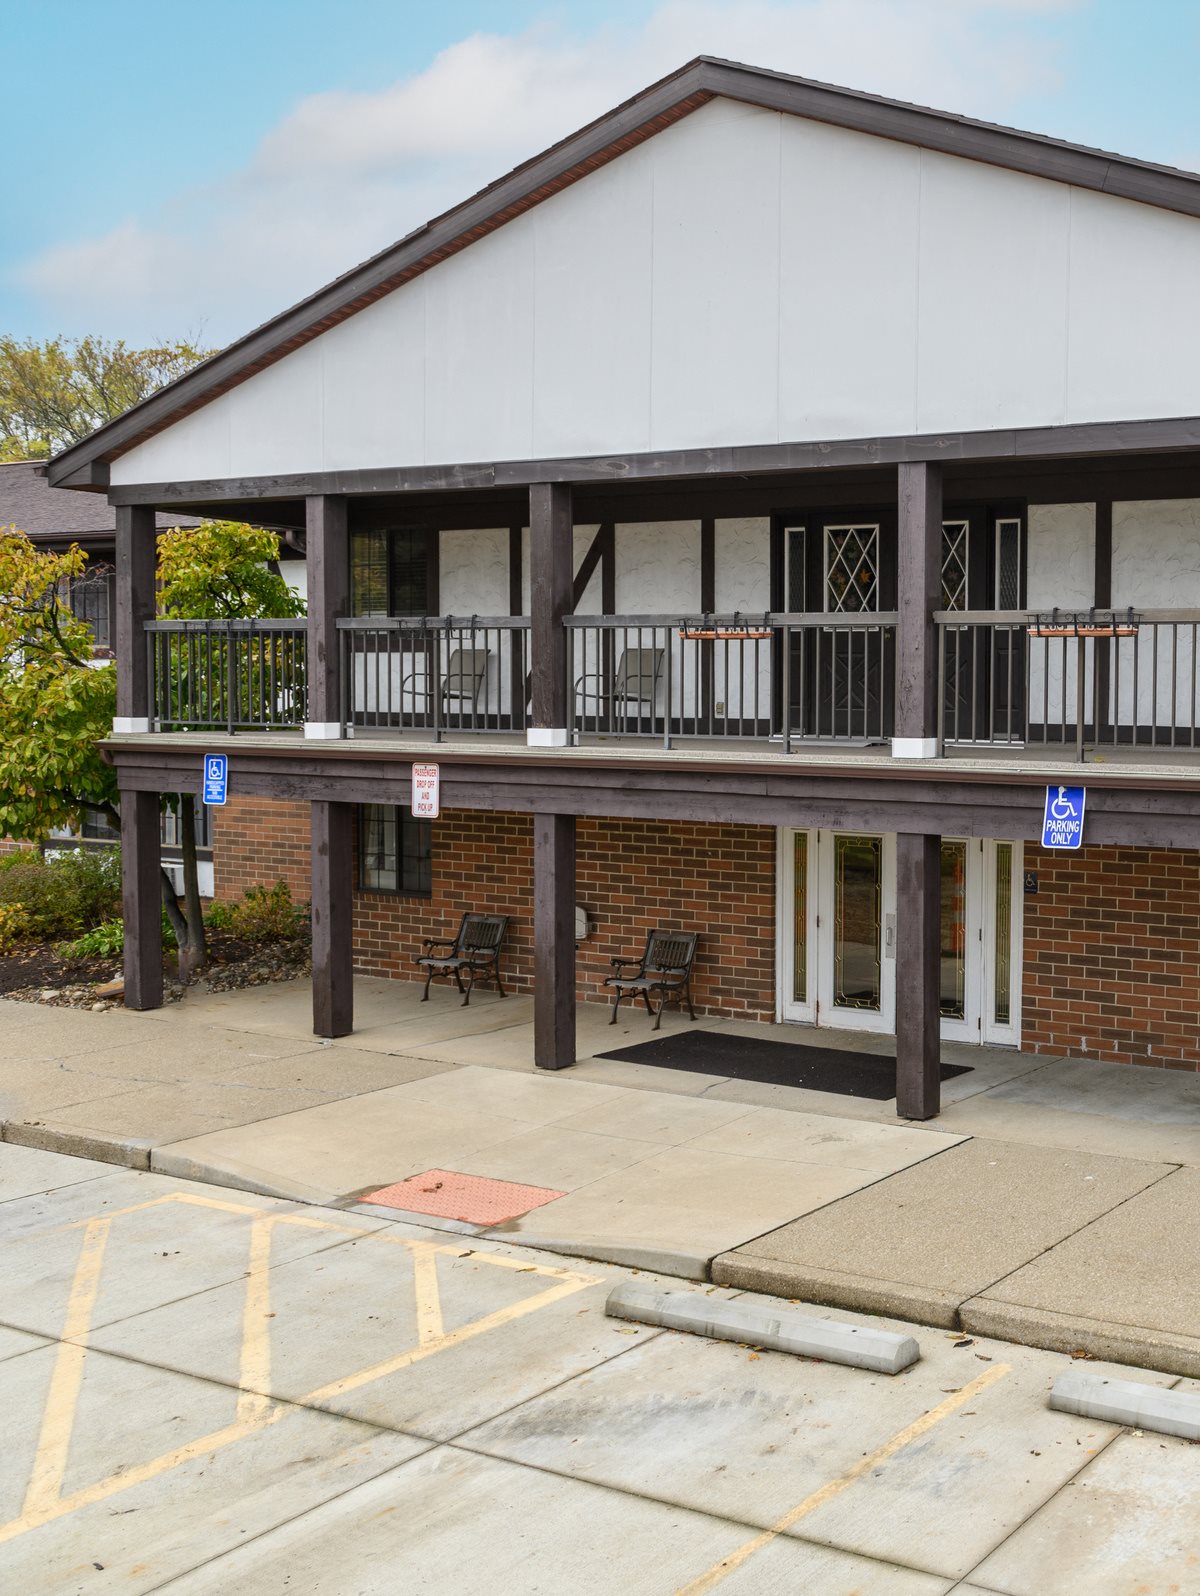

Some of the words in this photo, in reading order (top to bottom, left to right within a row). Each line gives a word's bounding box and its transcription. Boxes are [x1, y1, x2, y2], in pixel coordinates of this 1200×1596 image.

[415, 768, 437, 777] PASSENGER
[416, 780, 427, 788] DROP
[421, 792, 430, 800] AND
[417, 803, 427, 811] PICK
[427, 803, 433, 811] UP
[1046, 820, 1080, 833] PARKING
[1050, 832, 1073, 845] ONLY
